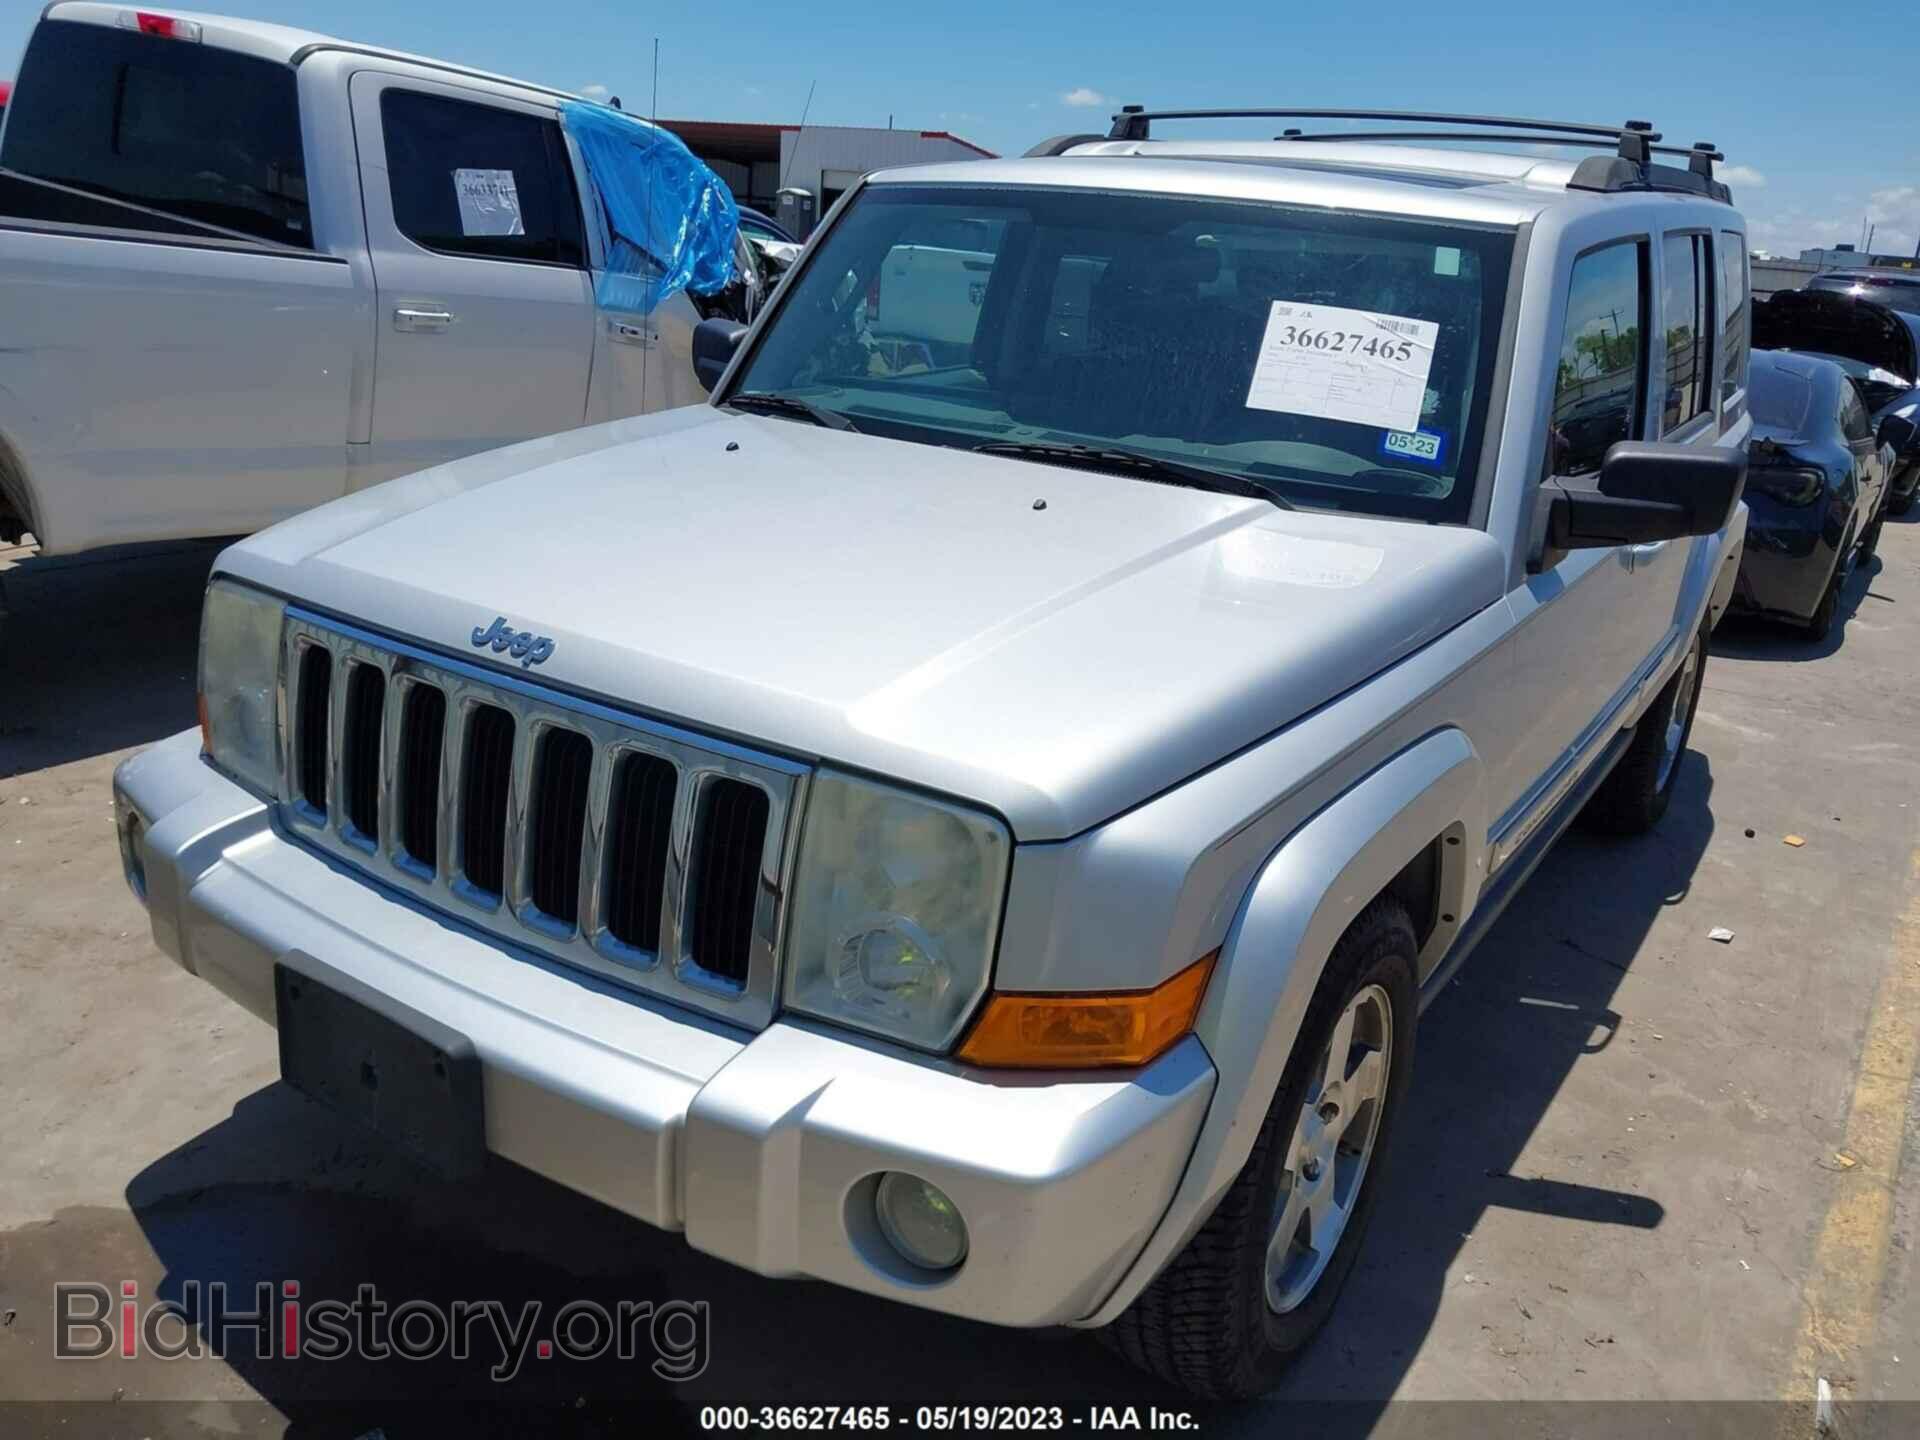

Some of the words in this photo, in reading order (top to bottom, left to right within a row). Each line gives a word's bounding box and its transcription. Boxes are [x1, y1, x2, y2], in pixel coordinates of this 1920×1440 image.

[1279, 325, 1413, 362] 36627465
[1388, 434, 1408, 448] 05
[1415, 439, 1435, 454] 23
[471, 616, 555, 669] Jeep
